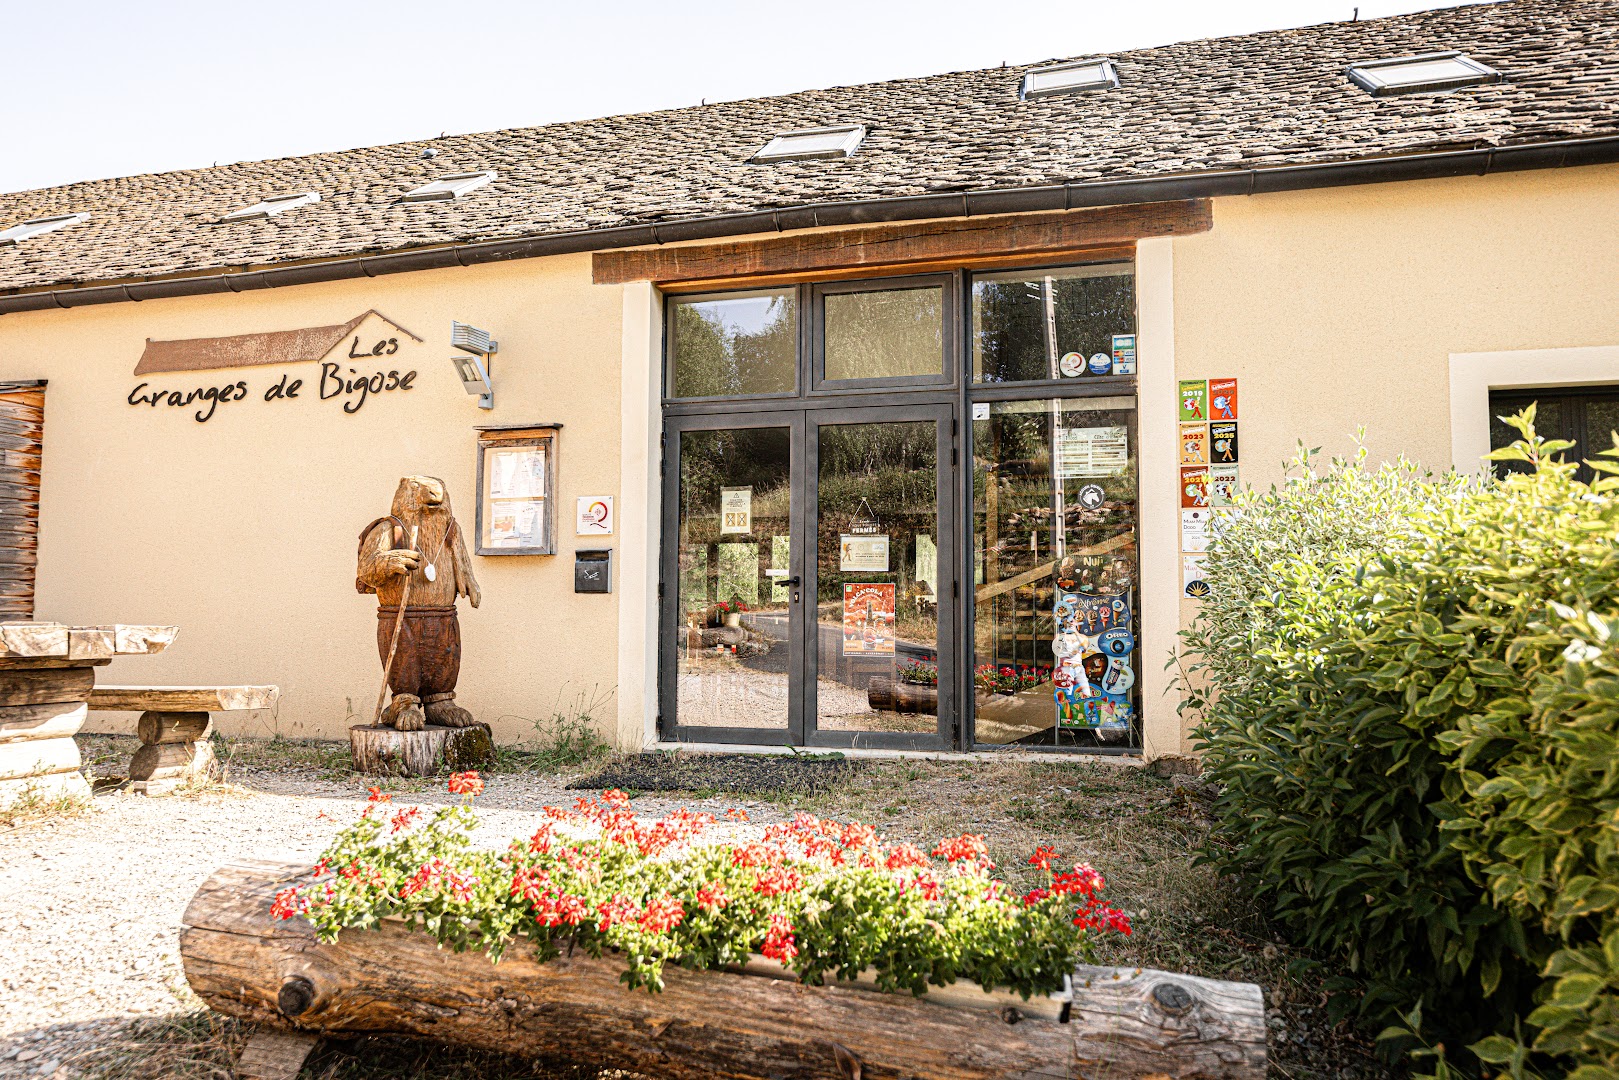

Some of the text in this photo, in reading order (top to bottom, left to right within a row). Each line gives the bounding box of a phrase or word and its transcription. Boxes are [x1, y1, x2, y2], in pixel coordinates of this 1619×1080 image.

[349, 336, 399, 359] Les
[128, 362, 417, 423] Granges de Bigose
[1083, 556, 1104, 567] Nuii
[1105, 632, 1129, 640] OREO
